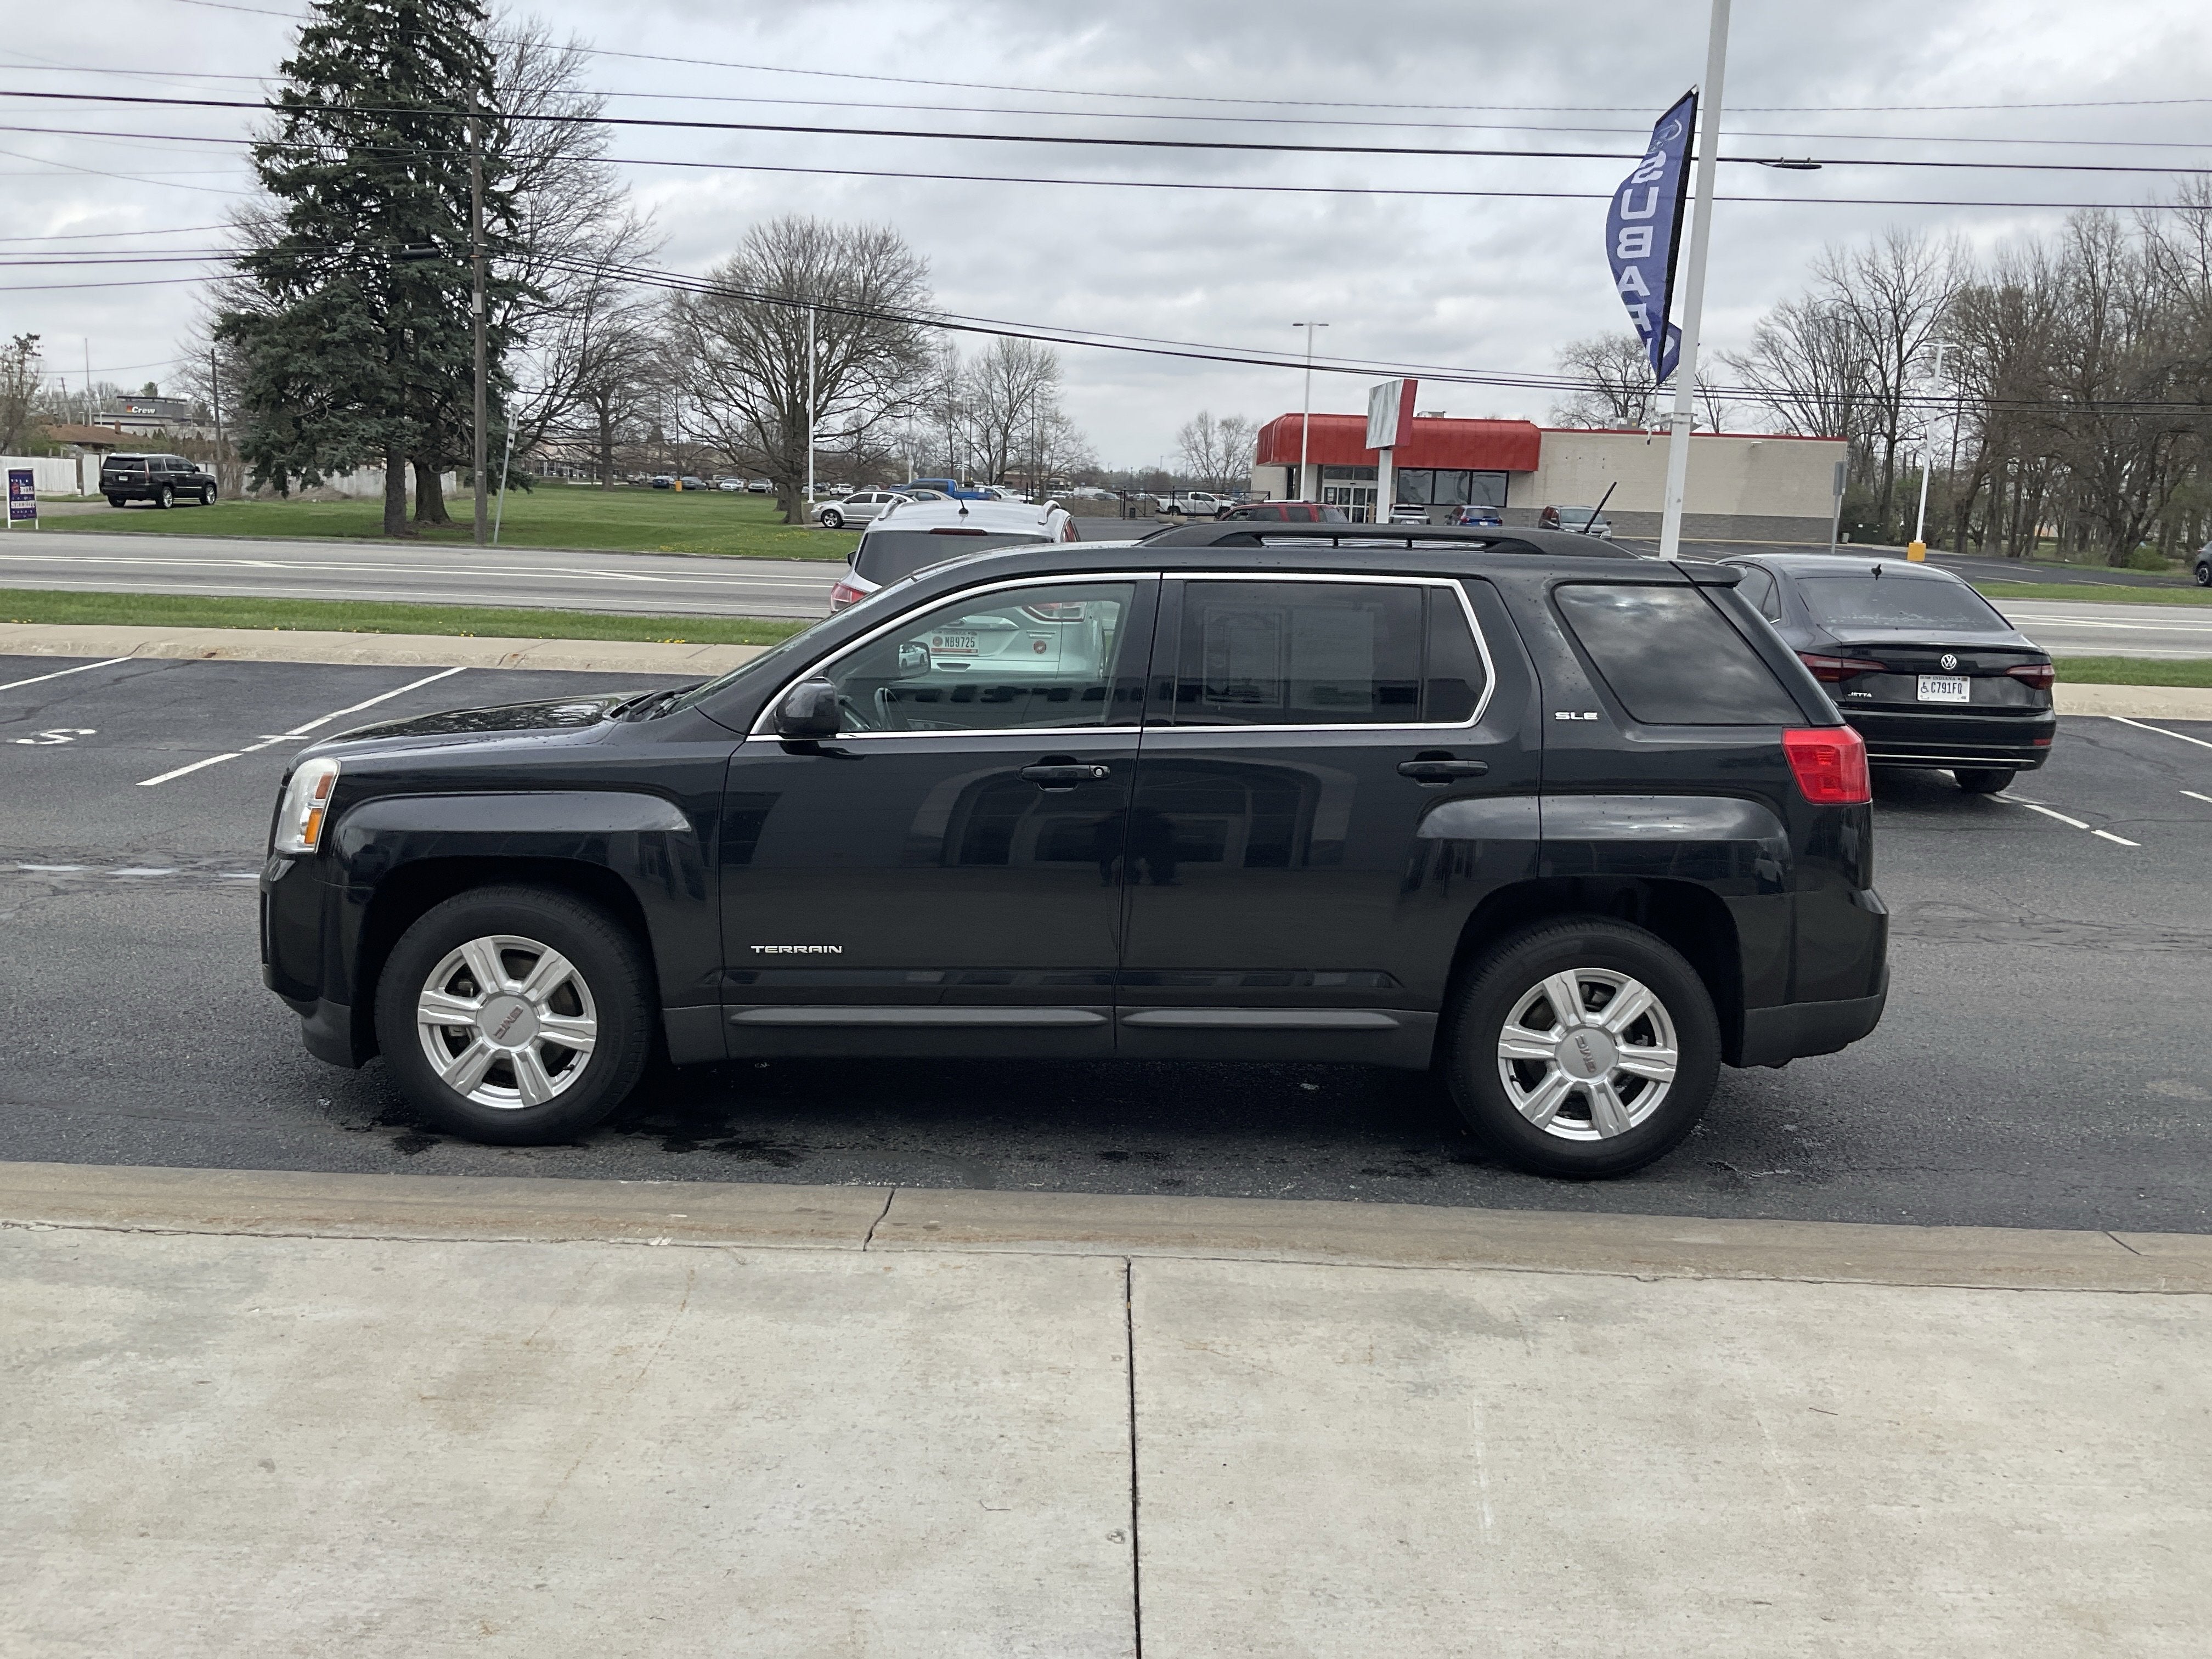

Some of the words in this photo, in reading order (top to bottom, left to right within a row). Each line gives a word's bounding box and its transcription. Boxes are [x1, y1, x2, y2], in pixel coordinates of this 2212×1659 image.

[1931, 682, 1962, 694] C791FQ
[1555, 712, 1598, 720] SLE
[751, 945, 842, 953] TERRAIN
